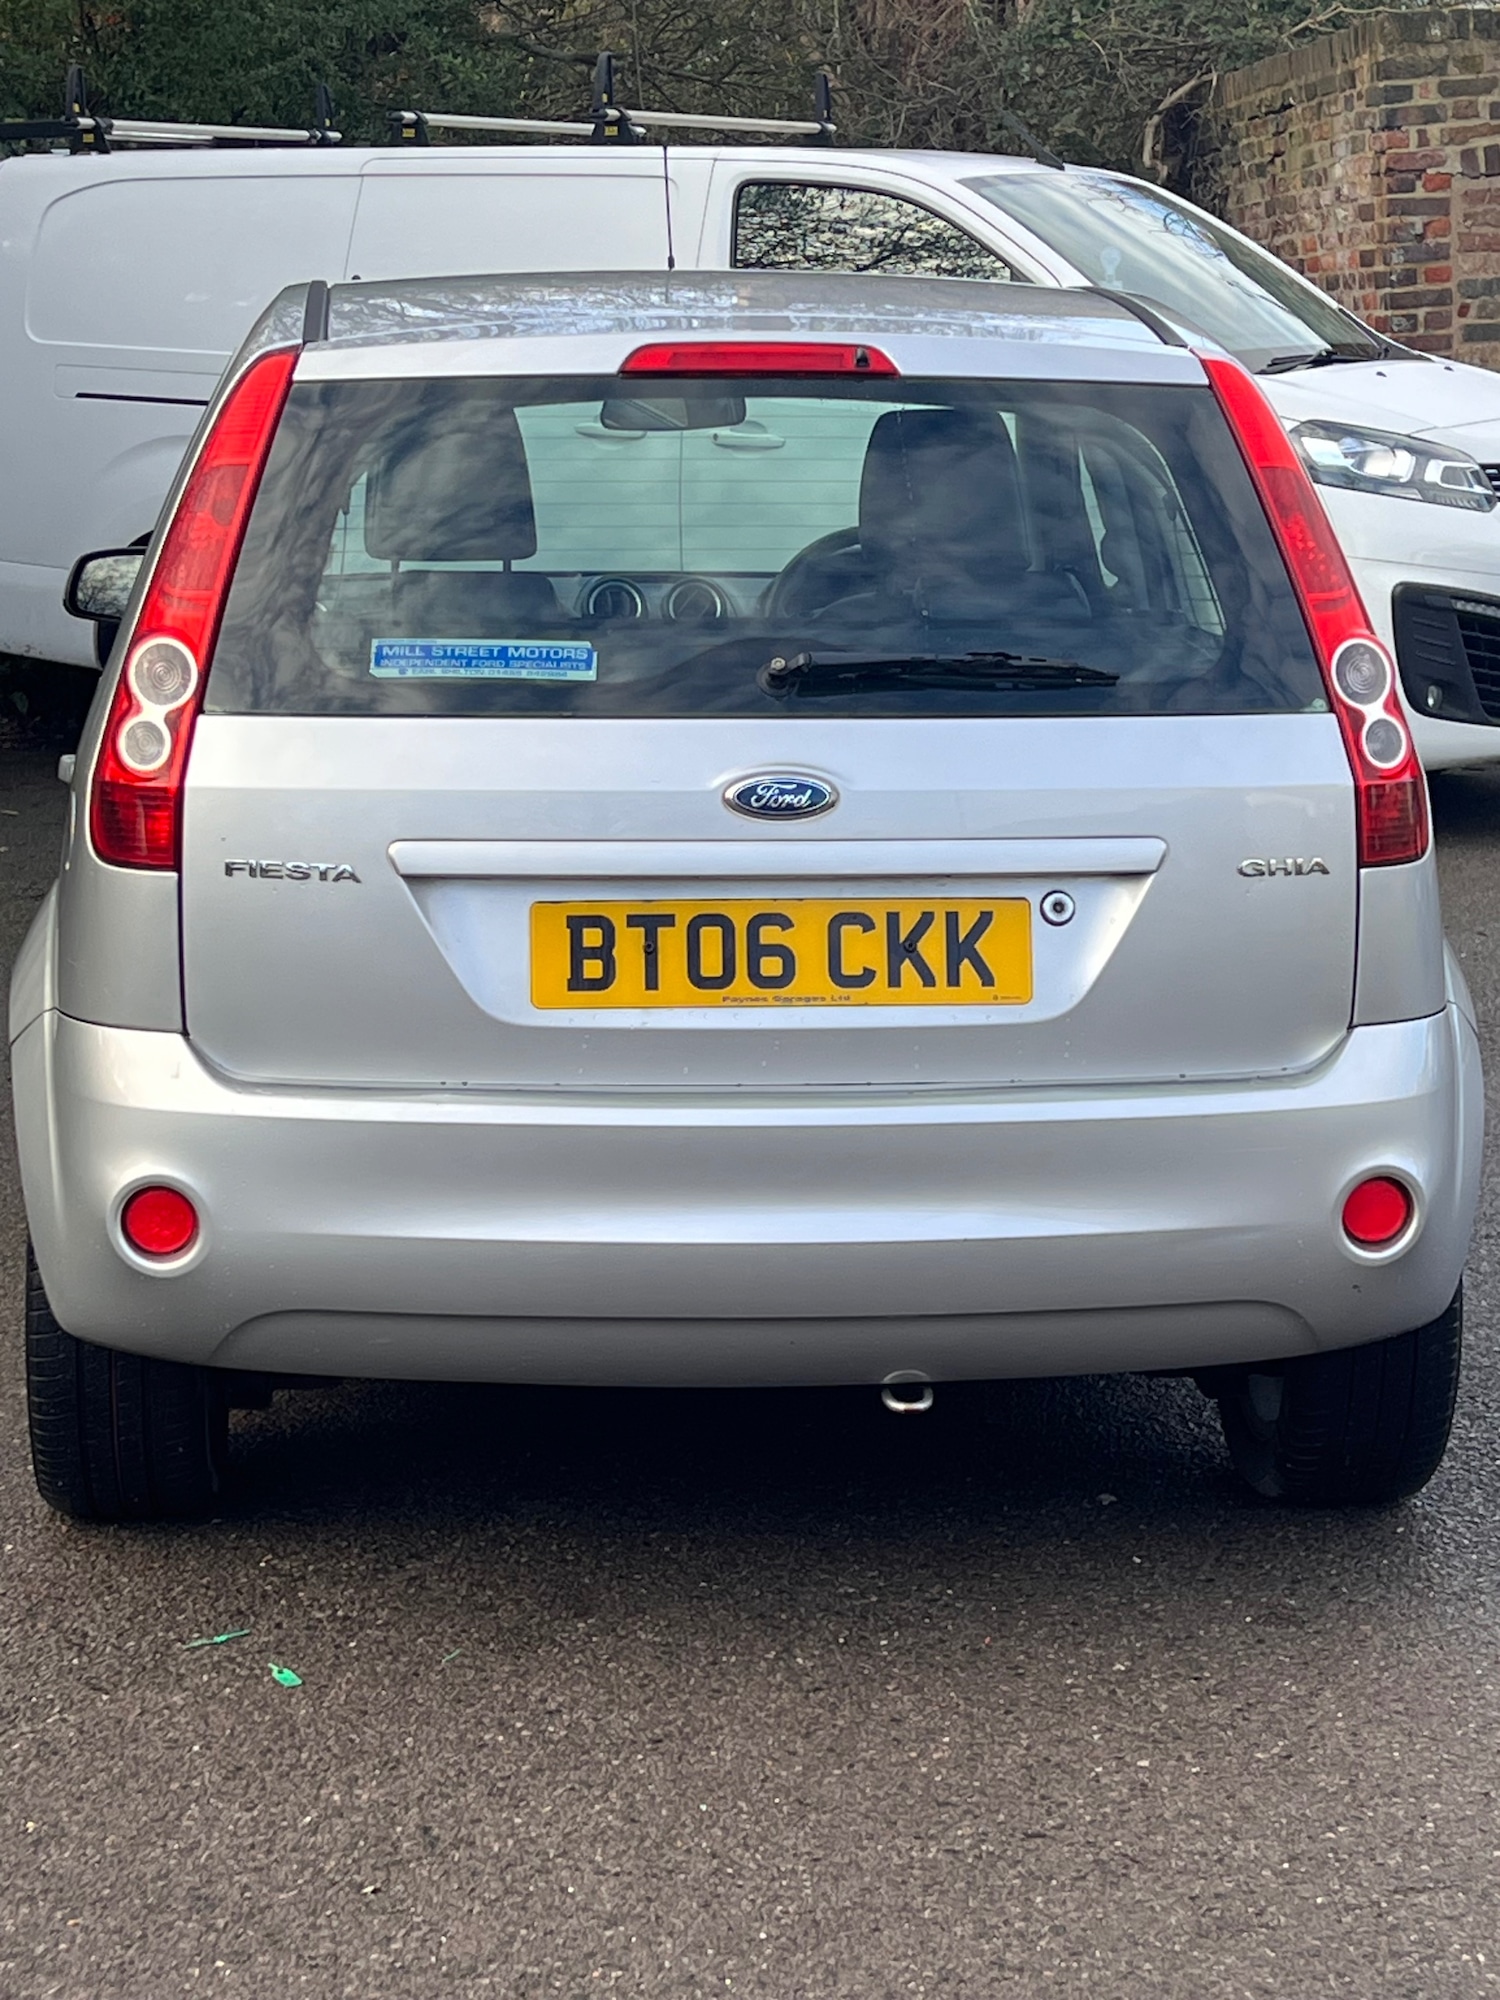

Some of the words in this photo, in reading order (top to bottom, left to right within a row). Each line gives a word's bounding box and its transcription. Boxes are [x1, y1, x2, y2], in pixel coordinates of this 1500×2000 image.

[382, 646, 425, 657] MILL
[431, 646, 502, 658] STREET
[508, 647, 588, 660] MOTORS
[380, 658, 468, 668] INDEPENDENT
[471, 659, 505, 669] FORD
[509, 660, 587, 671] SPECIALISTS
[751, 783, 813, 808] Ford
[224, 859, 362, 884] FIESTA
[1237, 857, 1330, 877] GHIA
[566, 912, 796, 991] BT06
[827, 910, 995, 989] CKK
[830, 994, 851, 1002] Ltd
